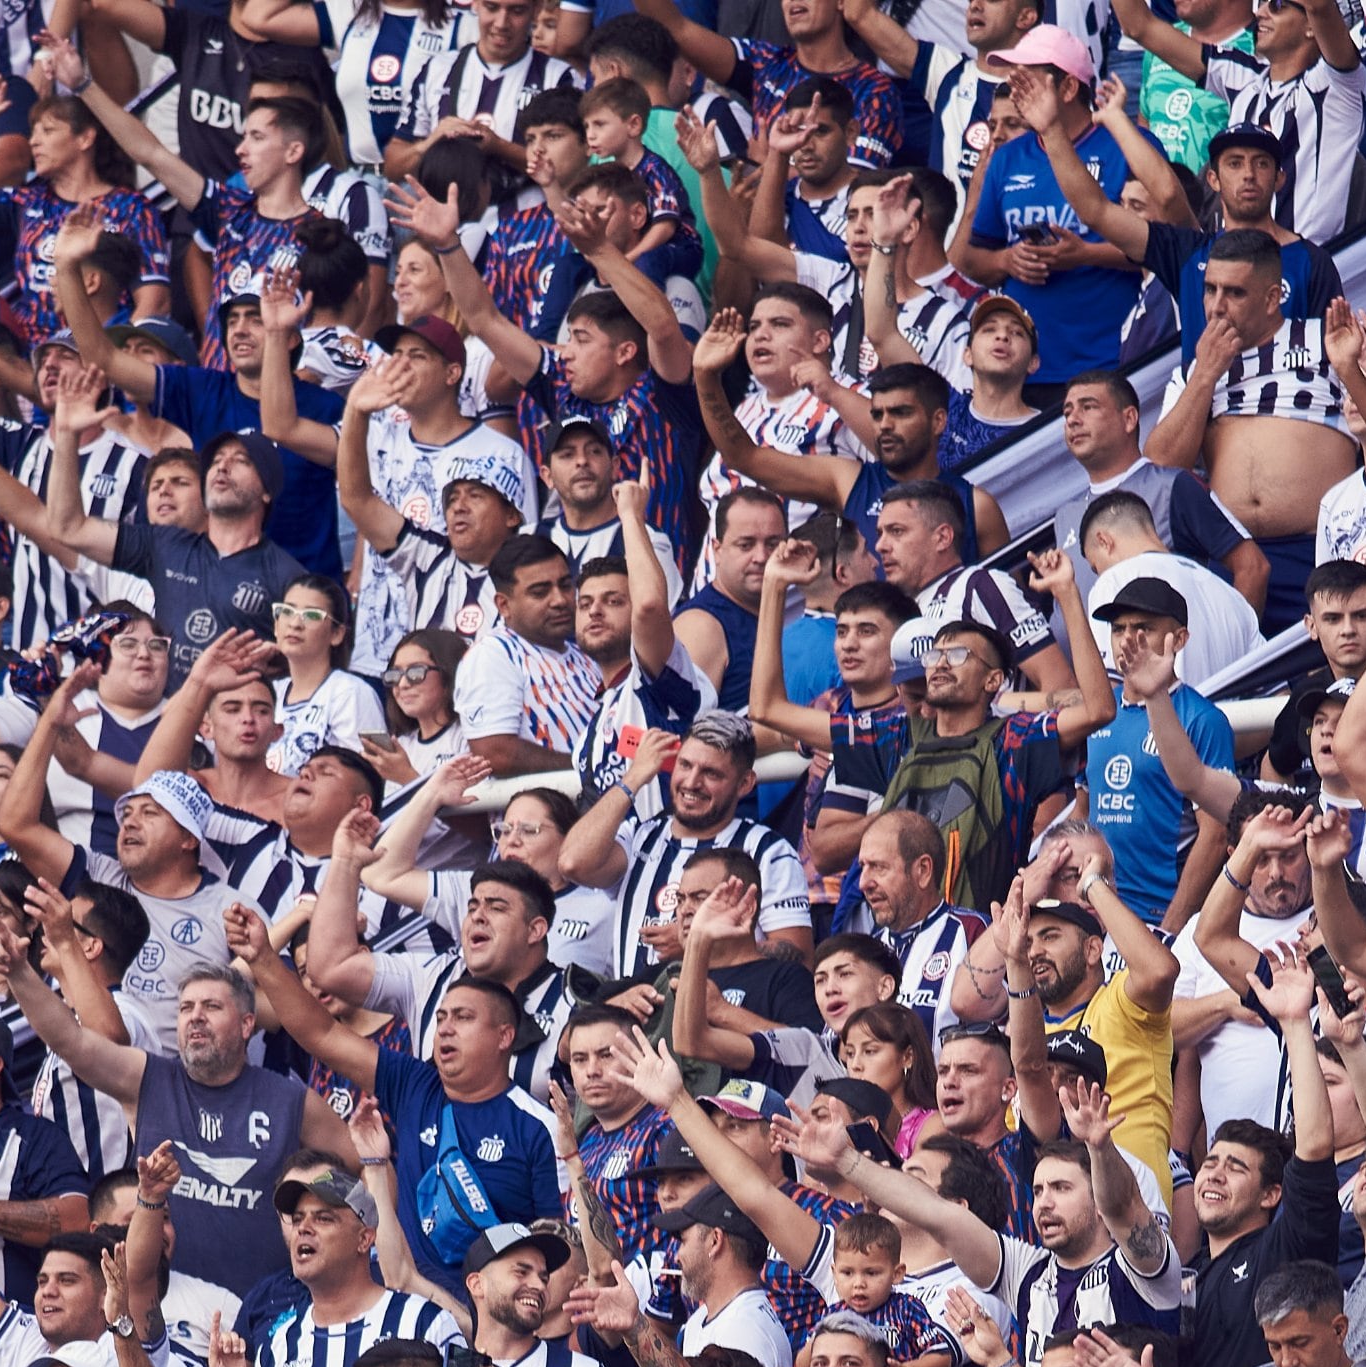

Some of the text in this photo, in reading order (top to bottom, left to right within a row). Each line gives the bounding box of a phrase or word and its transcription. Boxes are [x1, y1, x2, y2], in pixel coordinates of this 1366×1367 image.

[1097, 793, 1135, 809] ICBC
[1097, 814, 1132, 824] Argentina
[127, 975, 166, 993] ICBC
[450, 1160, 487, 1213] TALLERES
